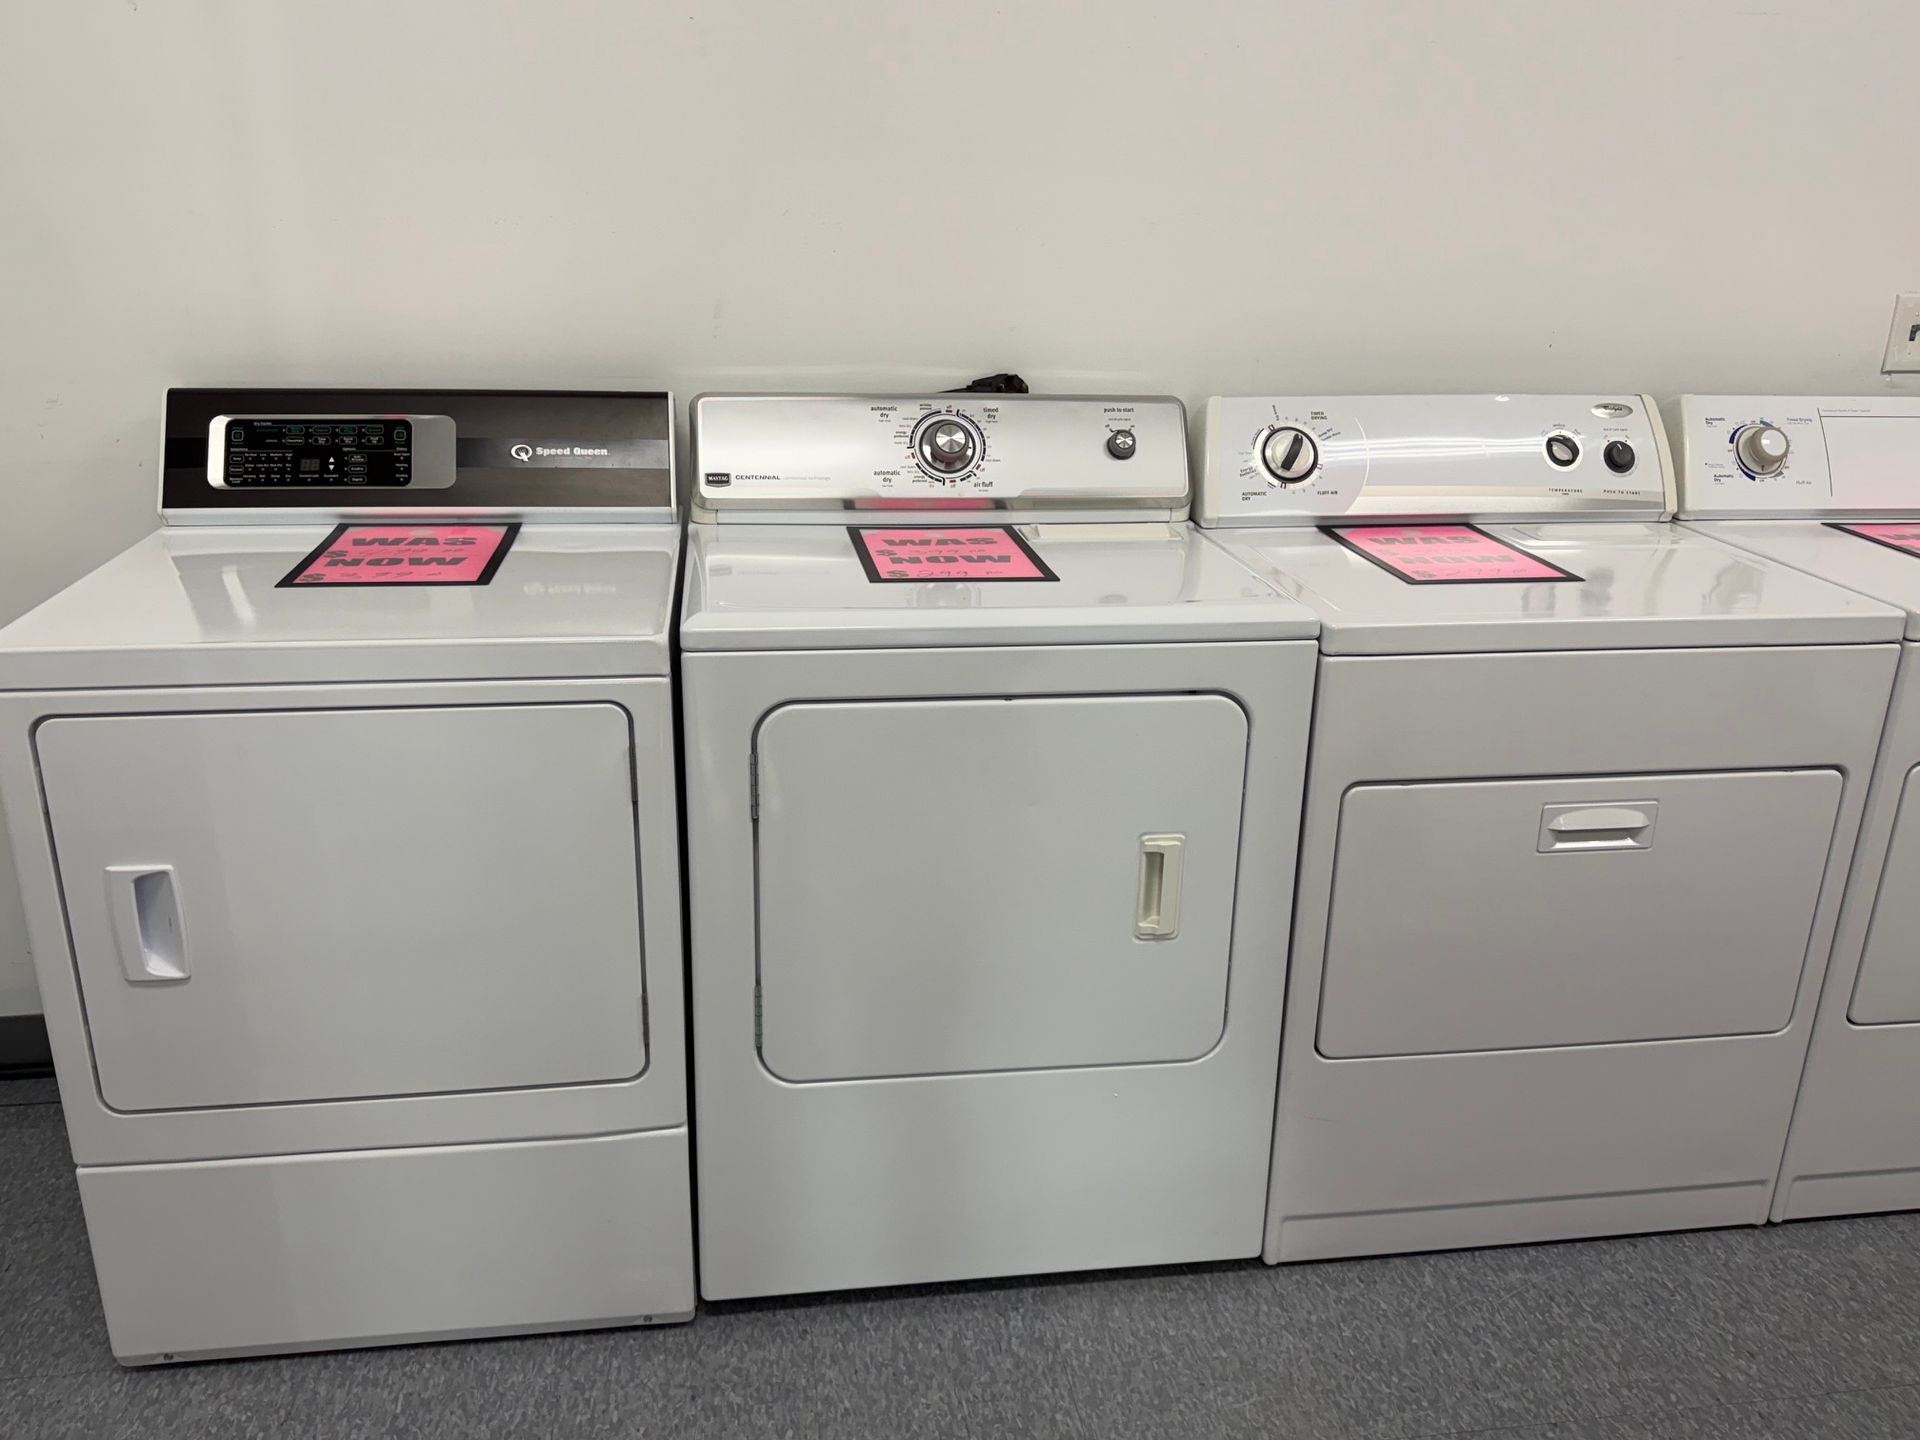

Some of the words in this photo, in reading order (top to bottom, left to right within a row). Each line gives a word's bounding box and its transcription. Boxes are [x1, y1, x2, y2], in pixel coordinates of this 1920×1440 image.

[536, 447, 570, 456] Speed
[573, 447, 608, 456] Queen
[352, 537, 477, 546] WAS
[881, 537, 997, 546] WAS
[1368, 536, 1481, 545] WAS
[324, 550, 348, 559] $
[324, 557, 468, 567] NOW
[889, 555, 1011, 564] NOW
[1398, 555, 1517, 564] NOW
[299, 573, 326, 582] $
[886, 570, 910, 578] $
